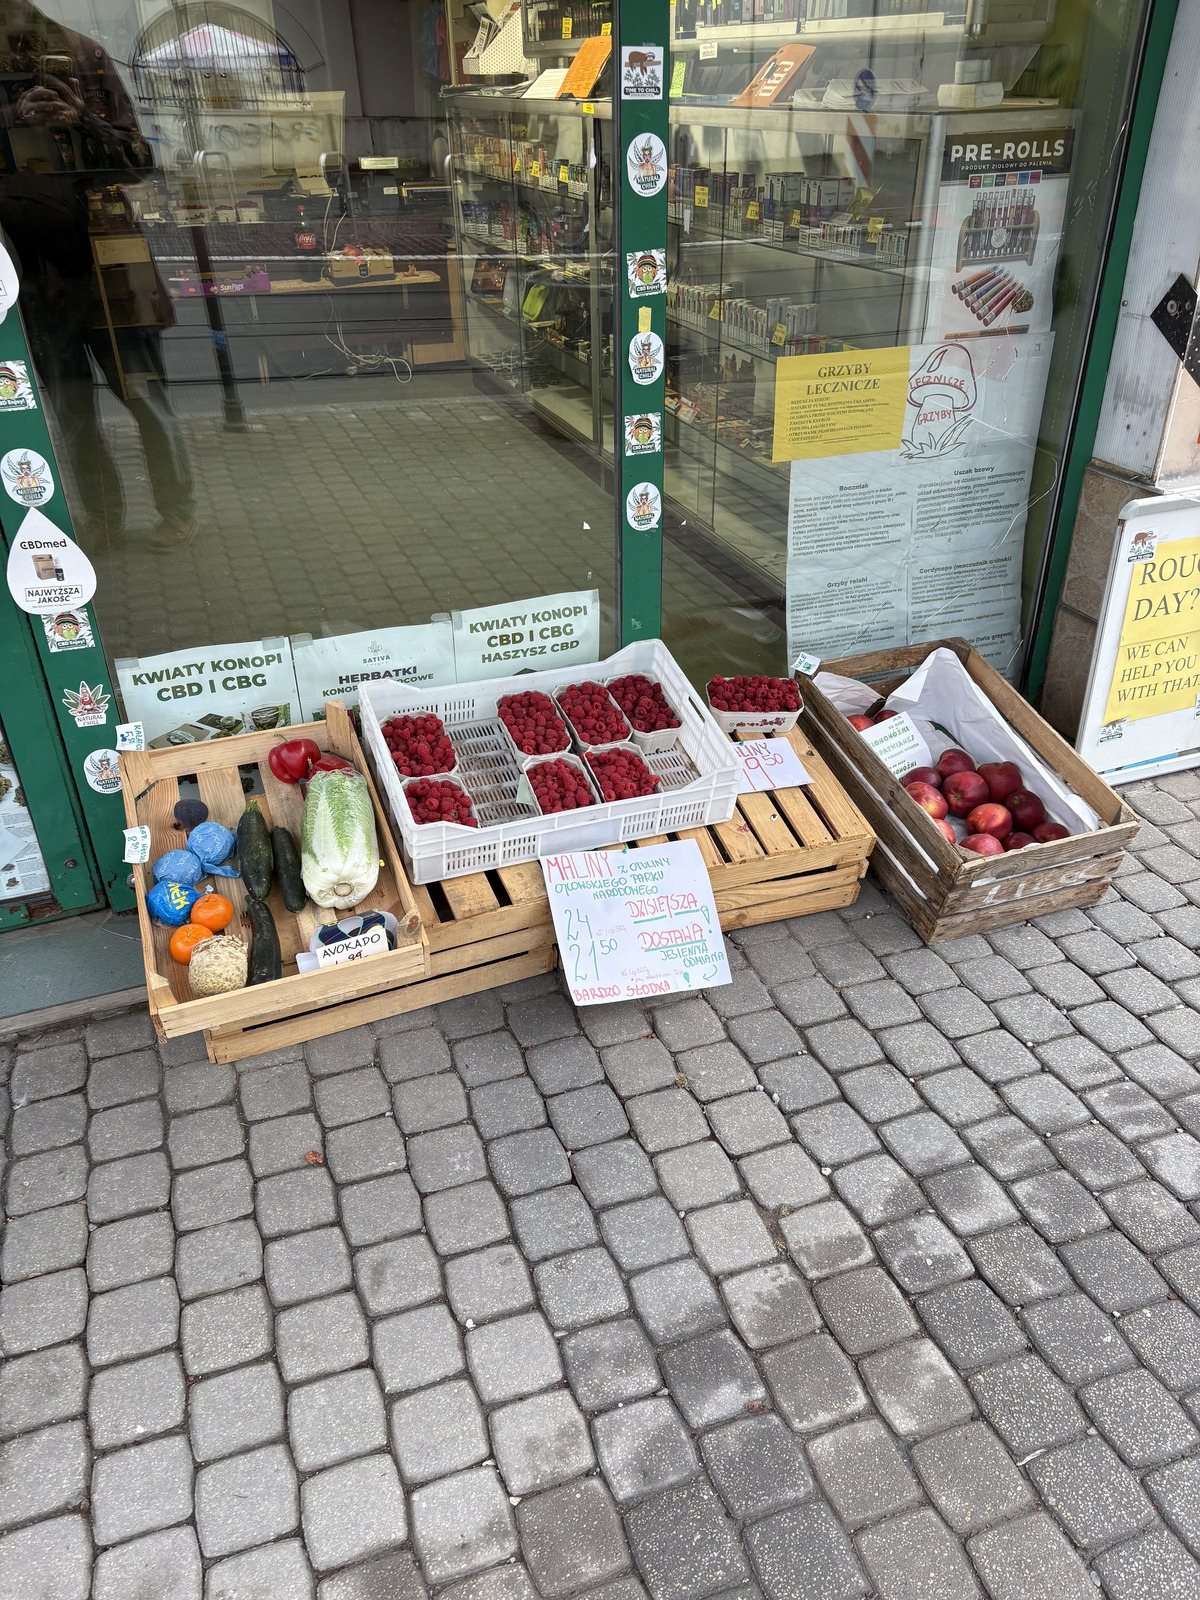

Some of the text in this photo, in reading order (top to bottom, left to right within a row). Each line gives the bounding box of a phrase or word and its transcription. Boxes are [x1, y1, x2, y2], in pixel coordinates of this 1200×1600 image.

[759, 61, 794, 97] CBD
[950, 139, 1064, 162] PRE-ROLLS
[638, 174, 660, 184] NATURAL
[641, 182, 656, 190] CHILL
[818, 363, 872, 378] GRZYBY
[806, 378, 880, 395] LECZNICZE
[909, 375, 965, 390] LECZNICZE
[917, 410, 952, 426] GRZYBY
[974, 466, 994, 474] bzowy
[16, 486, 46, 495] NATURAL
[839, 483, 869, 492] Boczniak
[20, 539, 67, 550] CBDmed
[920, 565, 952, 574] Cordyceps
[1139, 554, 1200, 586] ROU
[27, 586, 80, 597] NAJWYŻSZA
[827, 580, 848, 588] Grzyby
[37, 595, 70, 604] JAKOŚĆ
[1133, 587, 1200, 622] DAY?
[469, 605, 588, 634] KWIATY KONOPI
[487, 623, 574, 648] CBD I CBG
[481, 640, 580, 663] HASZYSZ CBD
[1127, 637, 1188, 661] WE CAN
[363, 655, 390, 664] SATIVA
[132, 653, 282, 686] KWIATY KONOPI
[338, 666, 417, 684] HERBATKI
[1120, 655, 1198, 683] HELP YOU
[156, 673, 267, 702] CBD I CBG
[322, 685, 358, 697] KONOP
[1117, 684, 1158, 702] WITH
[734, 742, 770, 757] LINY
[546, 852, 670, 883] MALINY Z OTULINY
[630, 871, 664, 884] PARKU
[593, 886, 658, 900] NARODOWEGO
[625, 893, 698, 918] DZISIEJSZA
[565, 909, 593, 941] 24
[637, 923, 704, 950] DOSTAWA
[322, 934, 380, 958] AVOKADO
[662, 942, 709, 961] JESIENNA
[569, 940, 599, 982] 21
[683, 951, 725, 968] ODMIANA
[573, 980, 670, 1002] BARDZO SŁODKA
